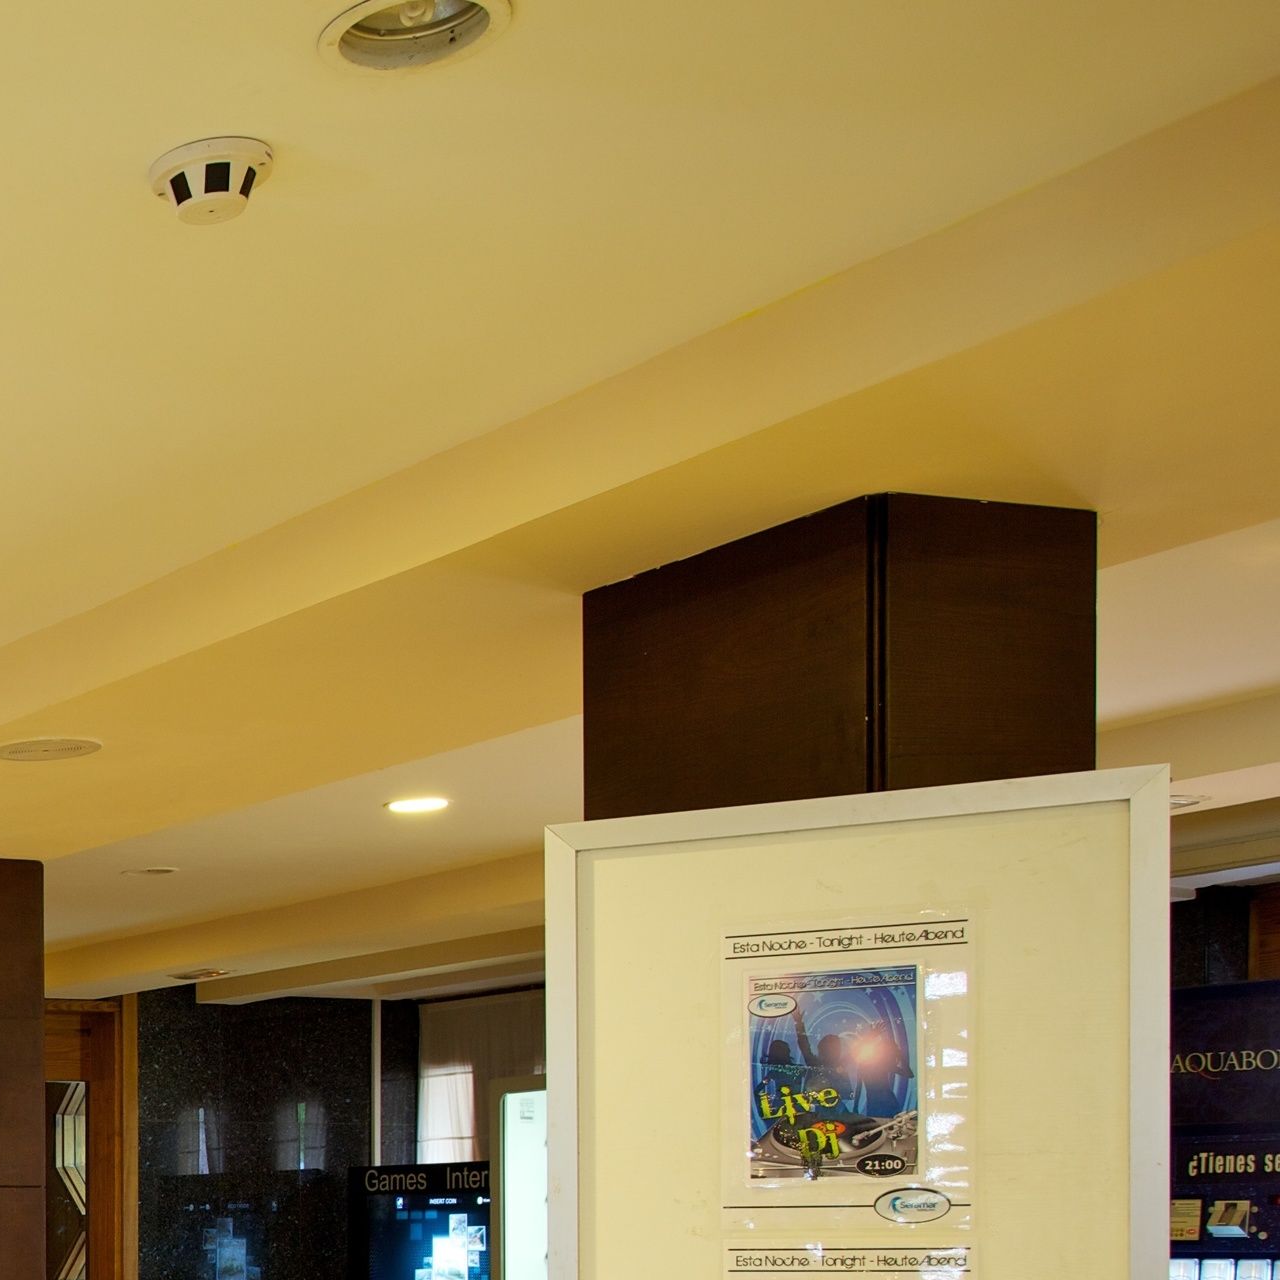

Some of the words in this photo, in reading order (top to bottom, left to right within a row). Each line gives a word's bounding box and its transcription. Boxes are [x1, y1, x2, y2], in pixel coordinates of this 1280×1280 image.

[733, 942, 760, 954] Esta
[762, 939, 807, 952] Noche
[816, 933, 863, 949] Tonight
[874, 932, 916, 945] Heute
[916, 927, 965, 941] Abend
[1170, 1049, 1280, 1080] AQUABO
[759, 1085, 840, 1125] Live
[797, 1121, 841, 1161] Dj
[864, 1160, 903, 1171] 21:00
[1188, 1152, 1256, 1177] ¿Tienes
[364, 1169, 427, 1191] Games
[446, 1167, 489, 1189] Inter
[899, 1197, 939, 1209] Seramar
[735, 1255, 763, 1267] Esta
[765, 1256, 810, 1267] Noche
[821, 1255, 867, 1269] Tonight
[877, 1255, 918, 1267] Heute
[919, 1255, 967, 1267] Abend
